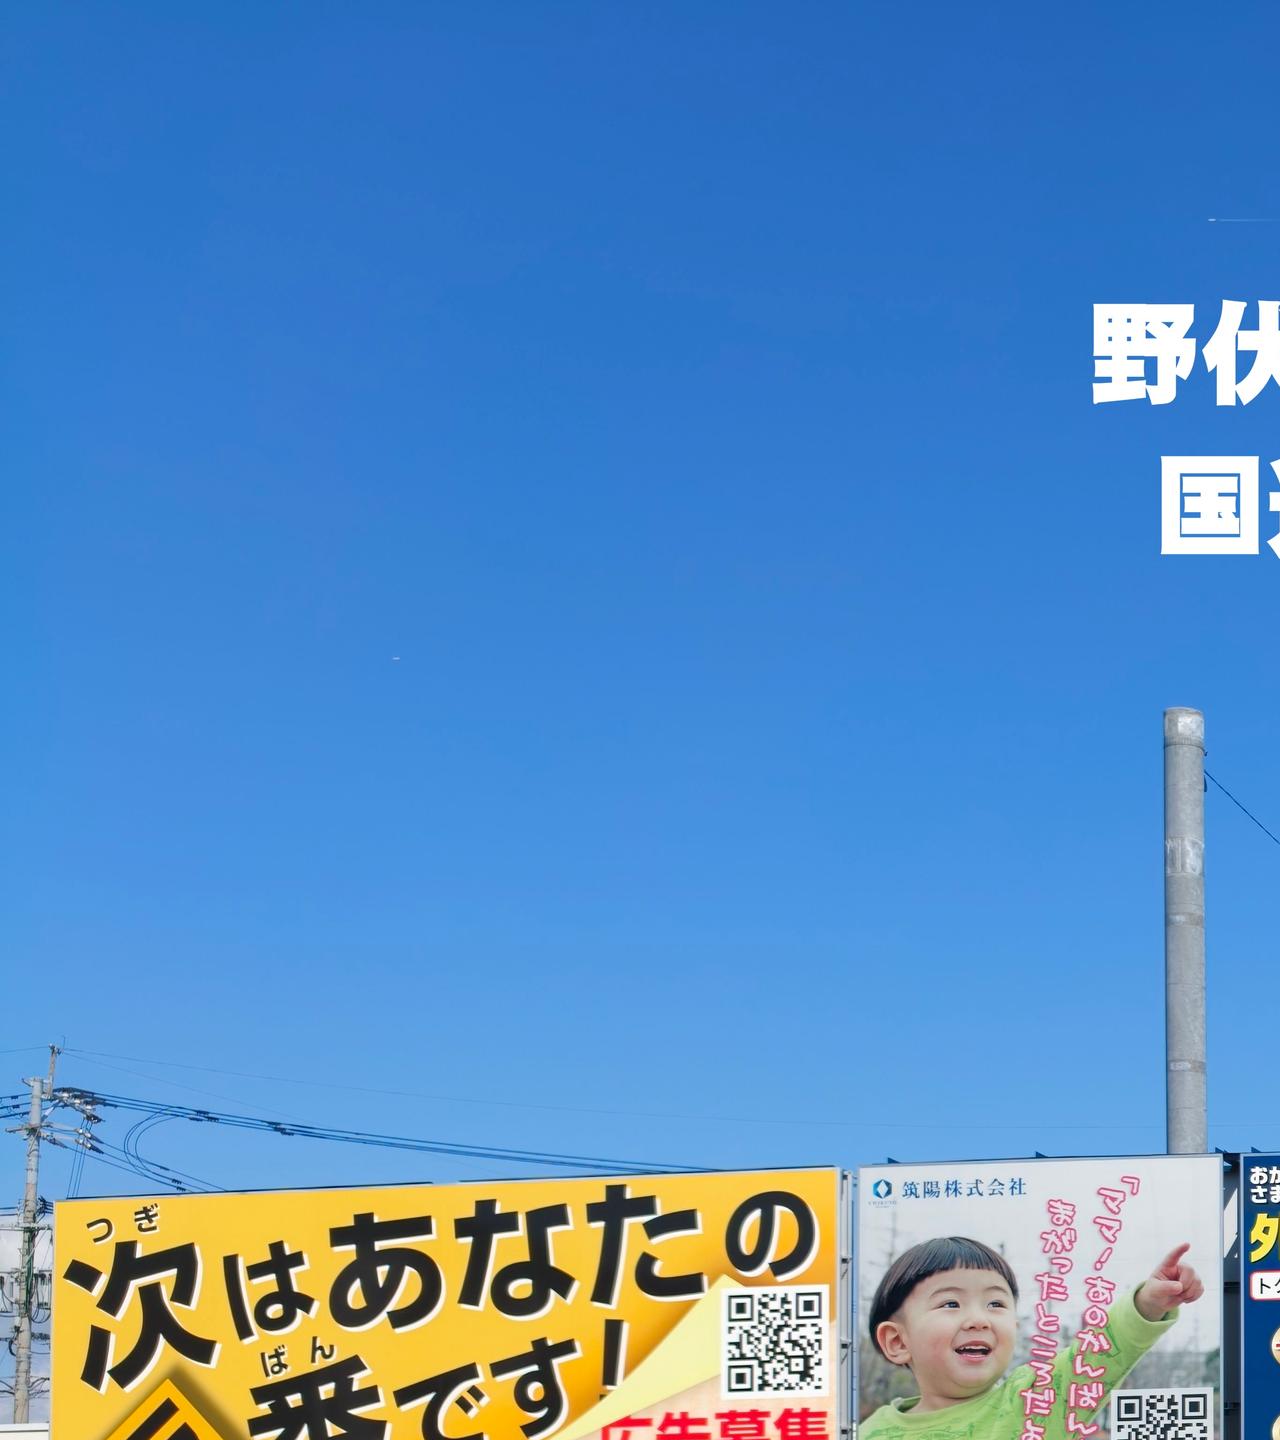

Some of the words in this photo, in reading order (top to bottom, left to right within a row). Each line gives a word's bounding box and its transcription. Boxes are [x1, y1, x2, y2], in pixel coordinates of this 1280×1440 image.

[902, 1177, 1027, 1199] 筑陽株式会社
[86, 1202, 160, 1243] つぎ
[63, 1184, 817, 1393] 次はあなたの
[260, 1336, 336, 1378] ばん
